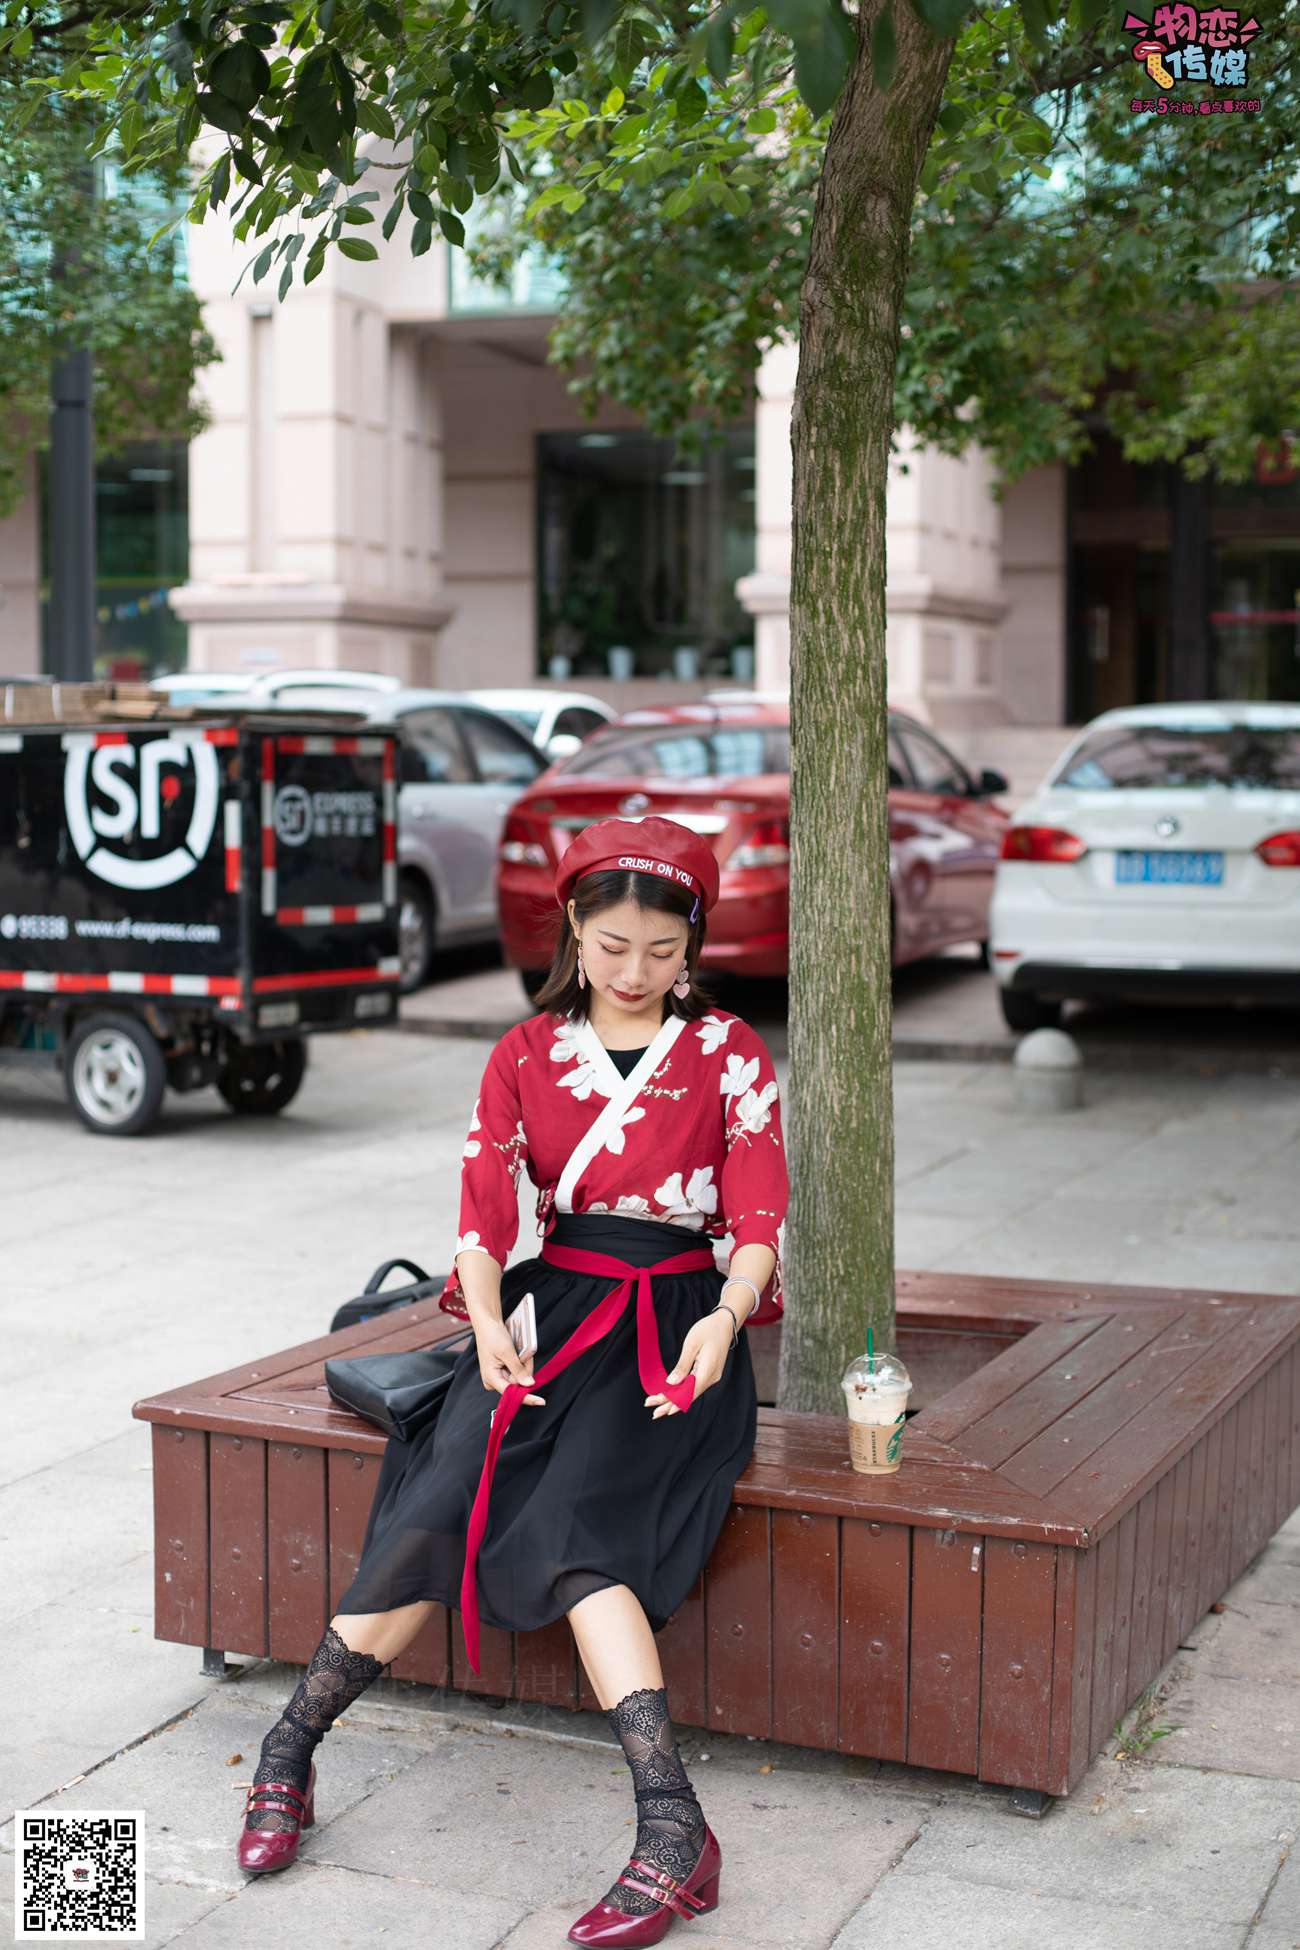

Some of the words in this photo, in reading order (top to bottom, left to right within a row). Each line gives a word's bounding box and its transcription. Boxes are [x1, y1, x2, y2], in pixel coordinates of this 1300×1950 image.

[618, 857, 653, 871] CRUSH
[656, 863, 673, 878] ON
[674, 869, 693, 887] YOU
